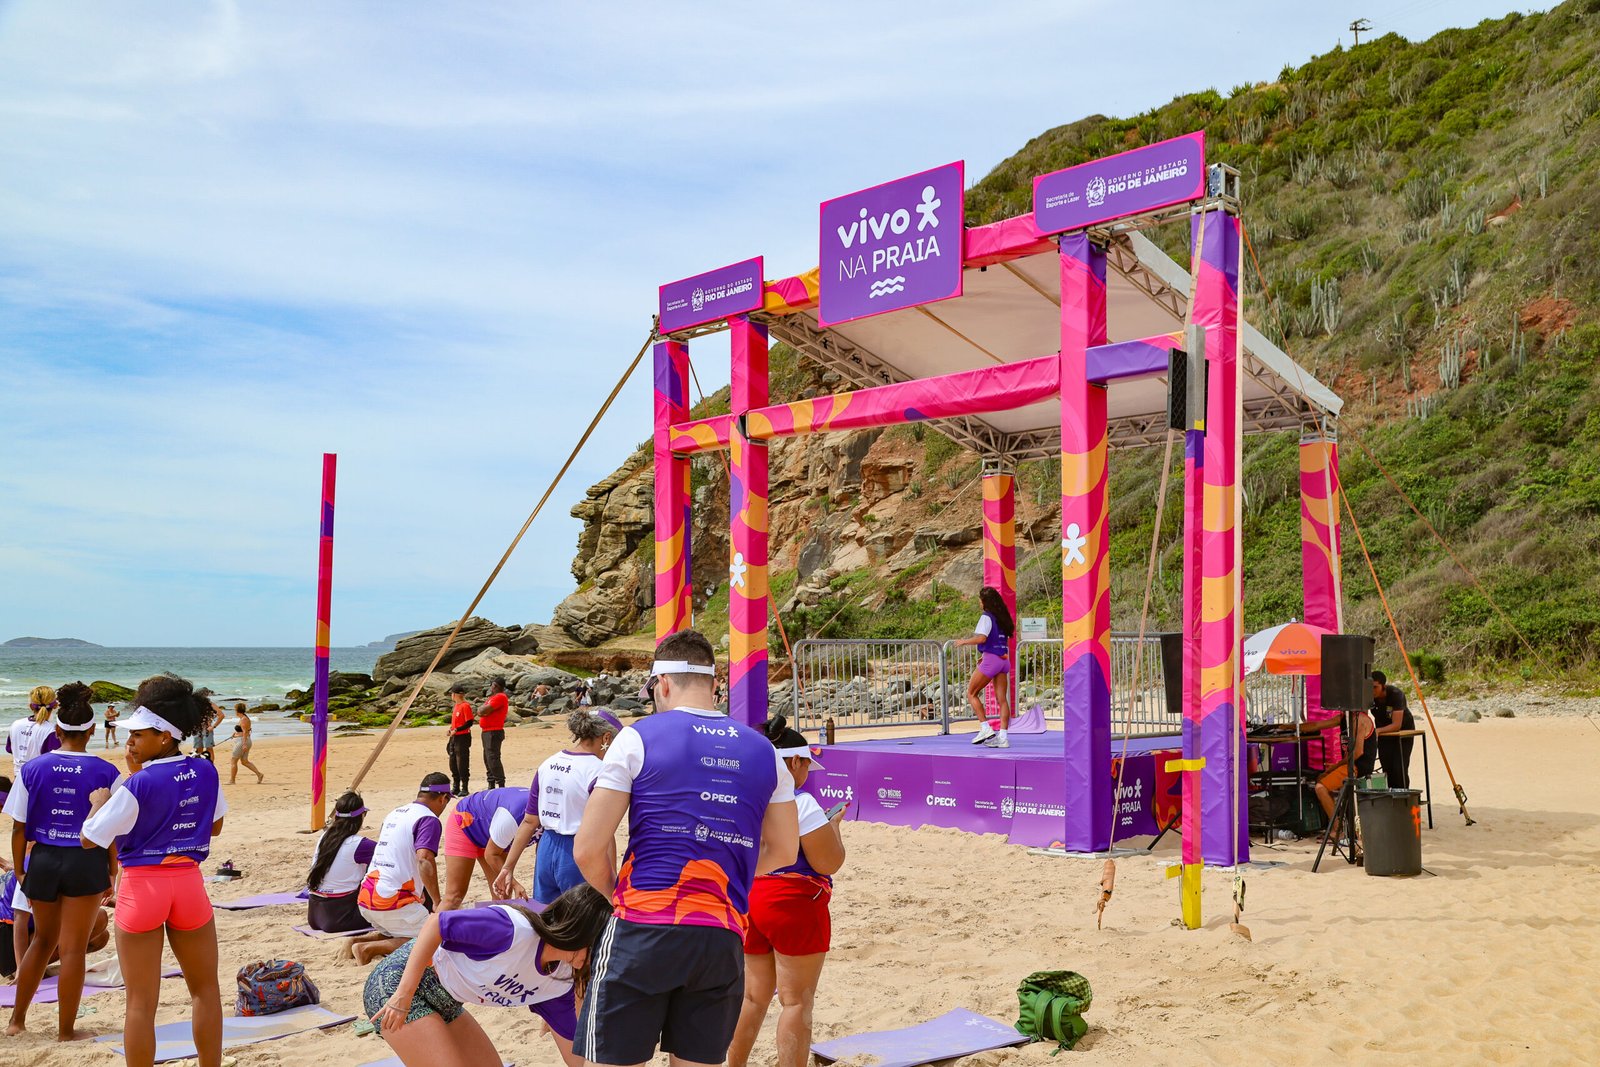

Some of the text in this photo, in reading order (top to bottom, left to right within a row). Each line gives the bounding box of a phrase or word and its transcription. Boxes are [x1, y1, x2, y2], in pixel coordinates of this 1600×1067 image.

[1107, 158, 1188, 185] GOVERNO DO ESTADO
[1107, 165, 1188, 195] RIO DE JANEIRO
[837, 207, 911, 249] vivo
[839, 235, 941, 282] NA PRAIA
[704, 282, 753, 303] RIO DE JANEIRO
[692, 724, 726, 736] vivo
[52, 764, 74, 773] vivo
[550, 762, 565, 772] vivo
[717, 757, 740, 767] BÚZIOS
[711, 793, 738, 804] PECK
[820, 785, 844, 799] vivo
[934, 796, 957, 807] PECK
[1121, 801, 1142, 814] PRAIA
[1015, 806, 1066, 817] RIO DE JANEIRO
[179, 822, 197, 830] PECK
[723, 835, 732, 843] DE
[731, 837, 754, 848] JANEIRO
[493, 973, 524, 995] vivo
